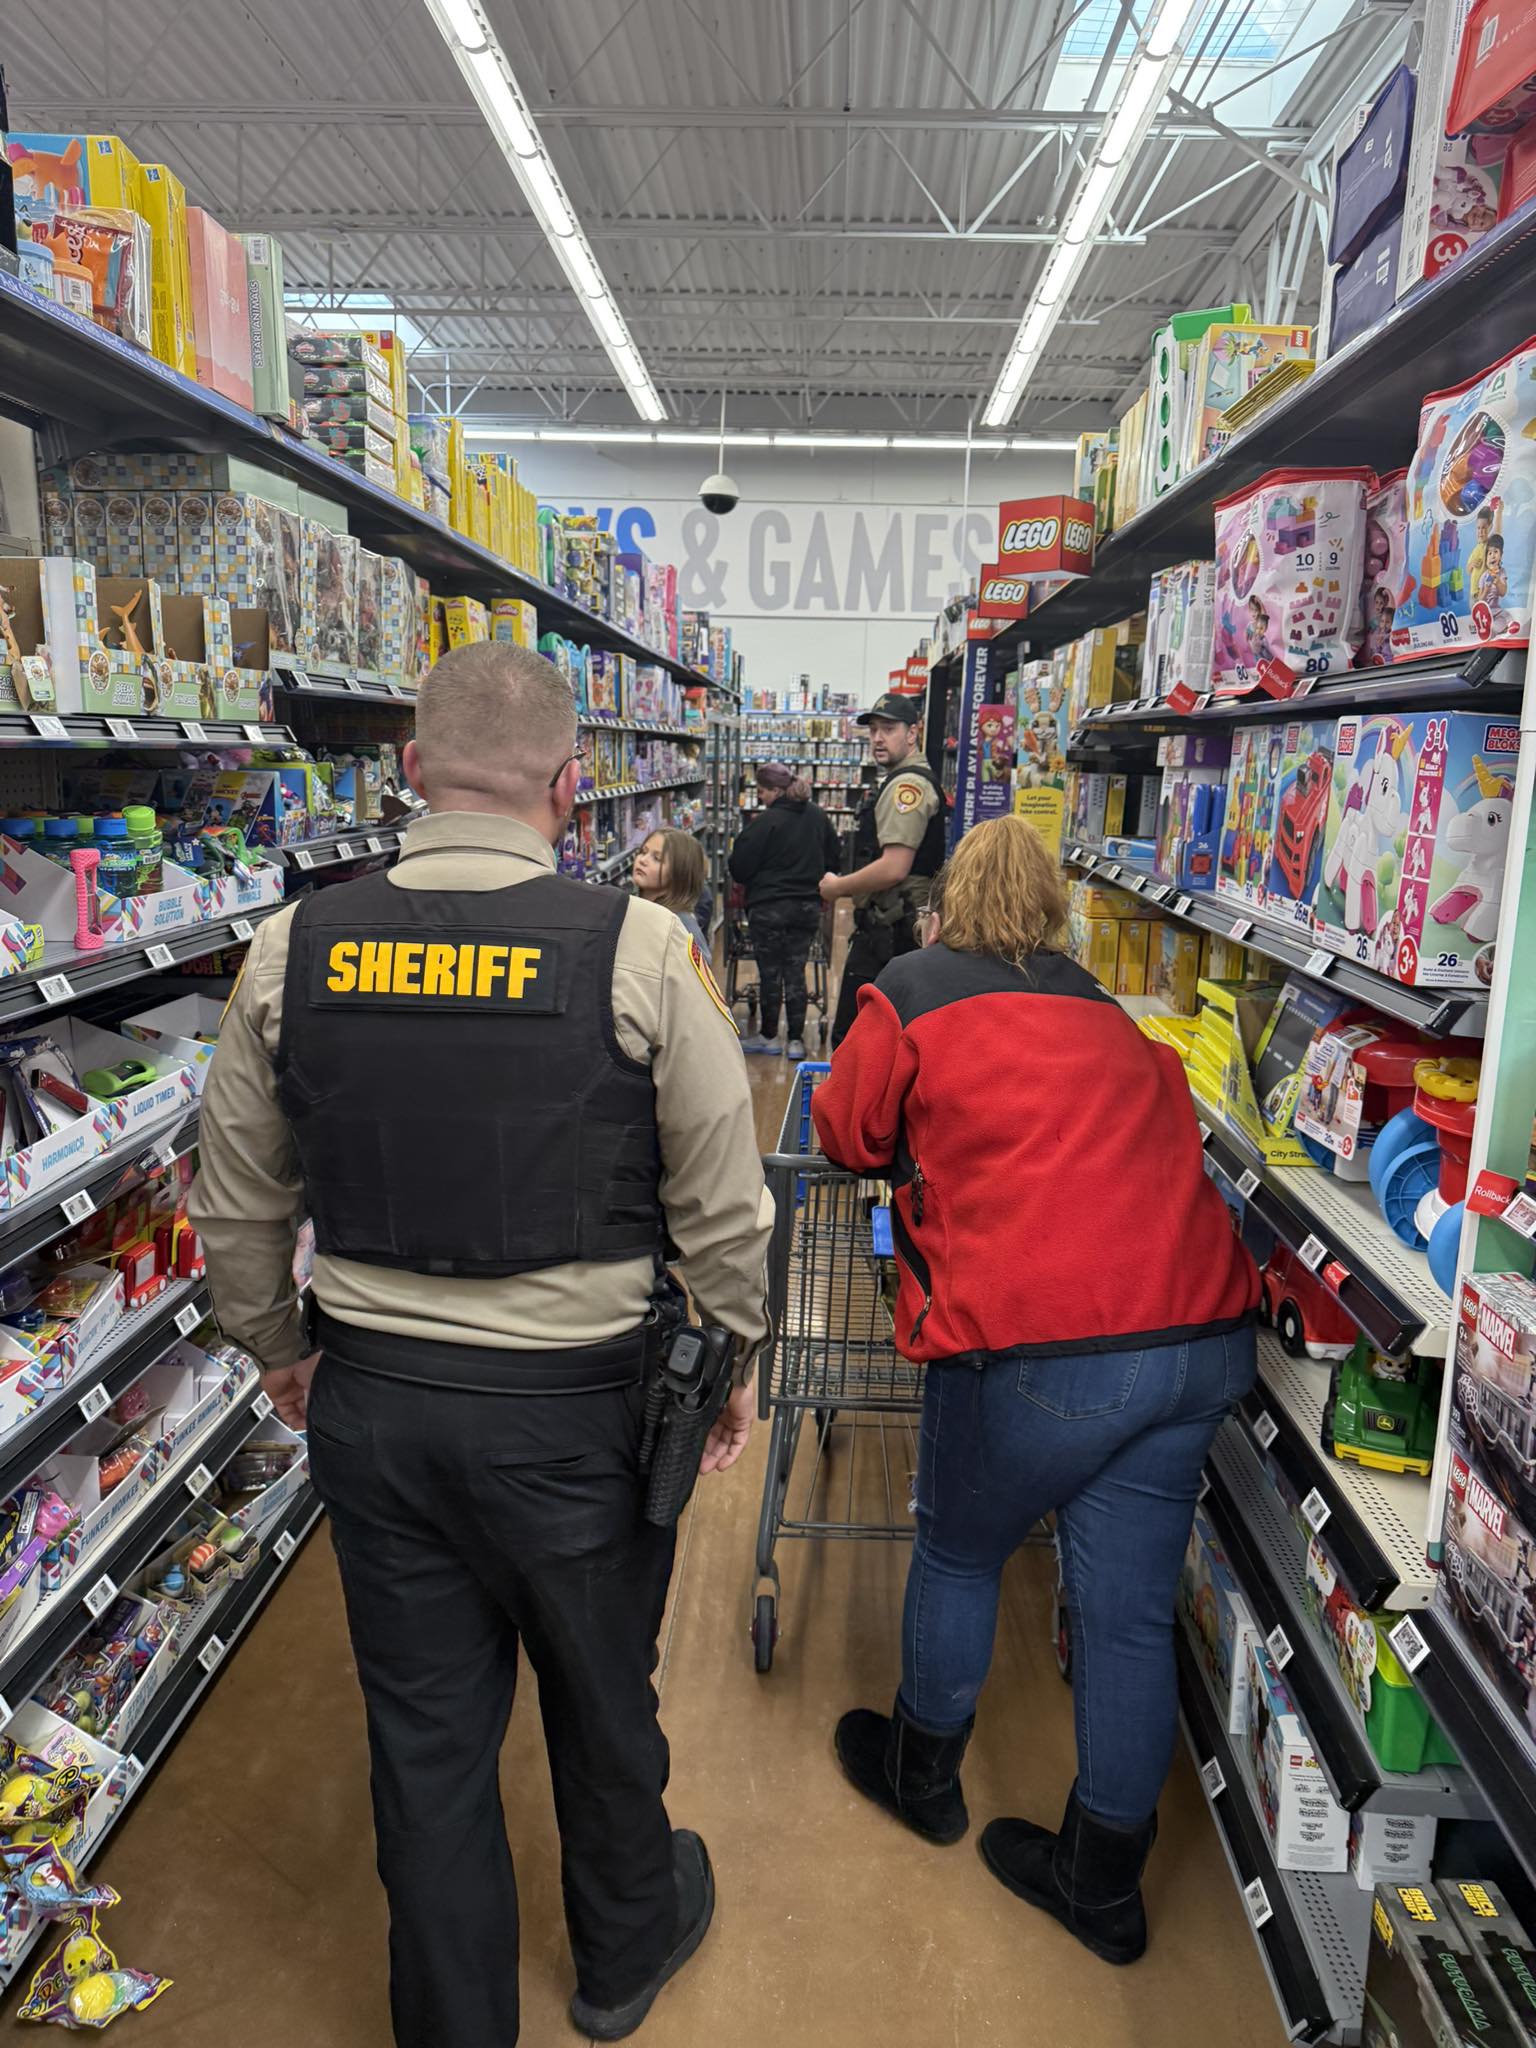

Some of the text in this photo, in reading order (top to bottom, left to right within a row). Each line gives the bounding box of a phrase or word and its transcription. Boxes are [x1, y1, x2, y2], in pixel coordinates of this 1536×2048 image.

[250, 280, 264, 368] SAFARI ANIMALS
[1002, 517, 1059, 552] LEGO
[1063, 519, 1092, 553] LEGO
[681, 508, 729, 610] &
[748, 510, 994, 612] GAMES
[1296, 552, 1339, 567] 10 9
[983, 581, 1027, 602] LEGO
[1441, 610, 1488, 638] 80 1+
[972, 646, 989, 711] FOREVER
[1236, 665, 1249, 681] 80
[1305, 657, 1330, 673] 80
[1487, 740, 1521, 751] BLOKS
[154, 908, 185, 926] SOLUTION
[158, 896, 183, 912] BUBBLE
[1356, 936, 1368, 960] 26
[1399, 945, 1414, 975] 3+
[1437, 953, 1458, 967] 26
[327, 941, 542, 999] SHERIFF
[133, 1086, 176, 1117] LIQUID TIMER
[42, 1136, 85, 1171] HARMONICA
[1270, 1150, 1288, 1159] City
[1474, 1185, 1512, 1205] Rollback
[1463, 1296, 1478, 1319] LEGO
[1480, 1305, 1515, 1360] MARVEL
[173, 1420, 196, 1450] FUNKEE
[1453, 1466, 1467, 1489] LEGO
[80, 1480, 139, 1551] FUNKEE MONKEE
[1469, 1480, 1504, 1539] MARVEL
[1408, 1887, 1437, 1921] BRICK
[1469, 1884, 1499, 1917] BRICK
[1437, 1952, 1491, 2031] FUTURAMA
[1501, 1947, 1536, 2010] FUTUR
